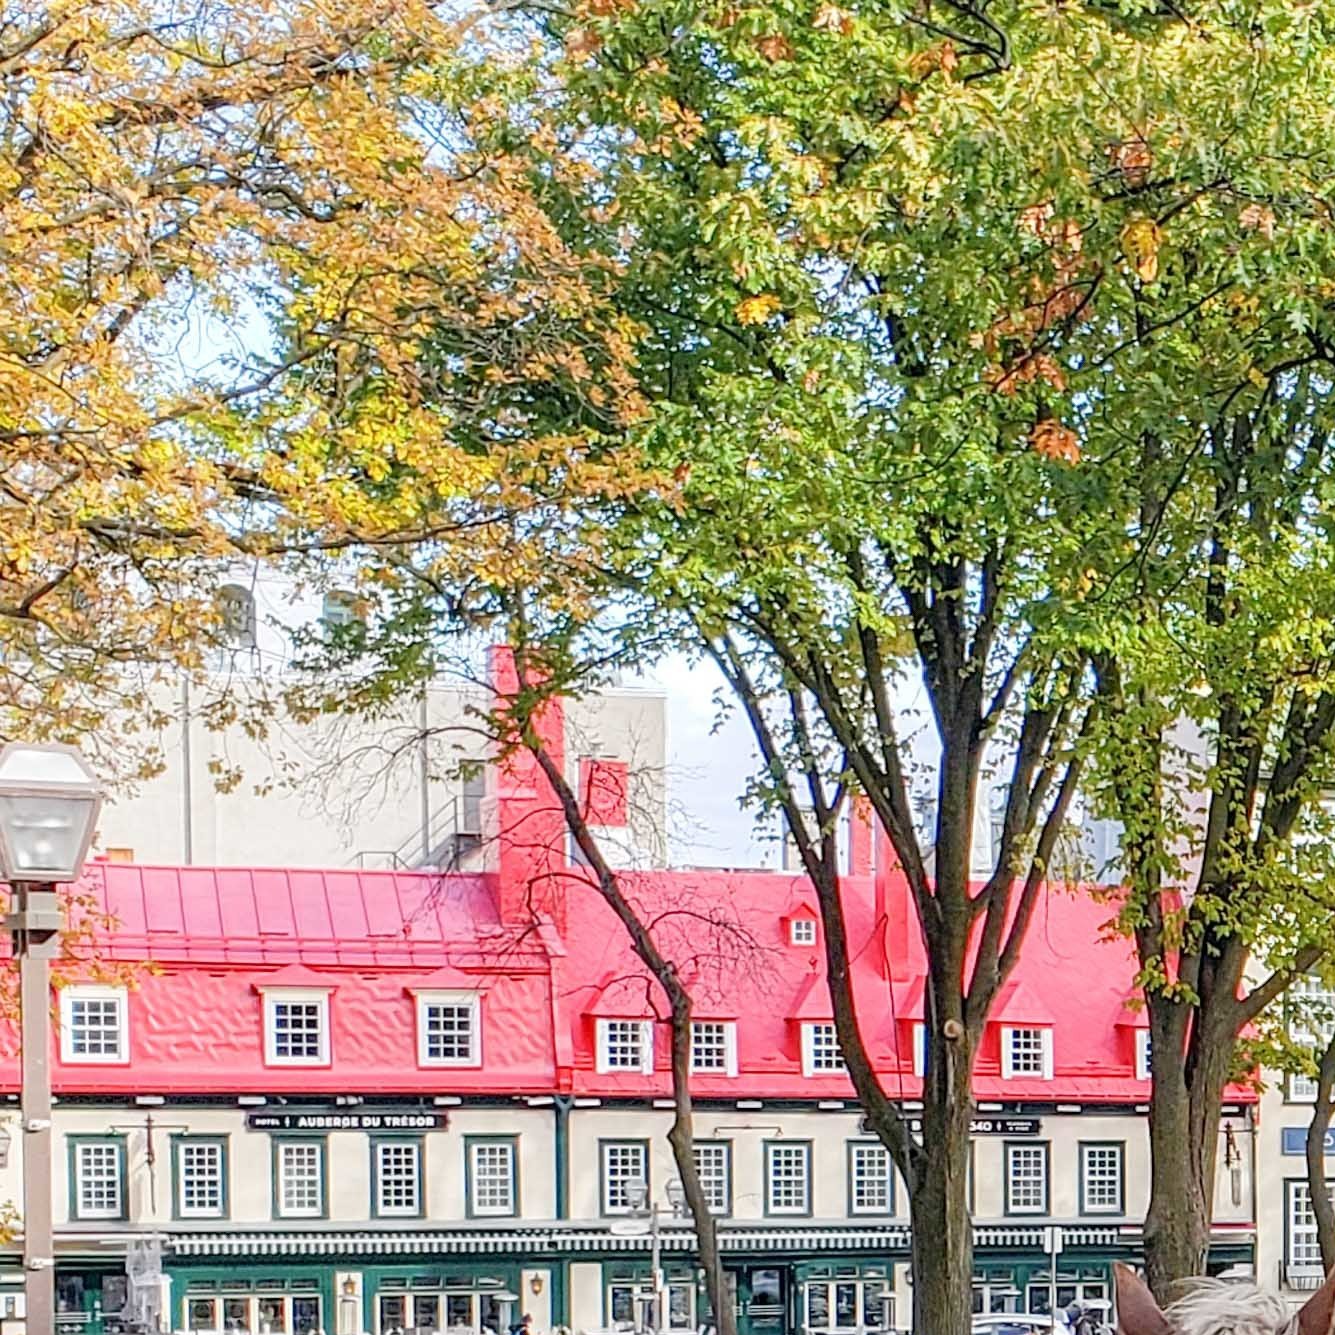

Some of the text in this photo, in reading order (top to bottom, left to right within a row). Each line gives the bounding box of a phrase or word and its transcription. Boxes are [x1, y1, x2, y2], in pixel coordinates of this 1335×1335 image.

[297, 1116, 359, 1128] AUBERGE
[362, 1117, 382, 1128] DU
[384, 1115, 435, 1127] TRÉSOR
